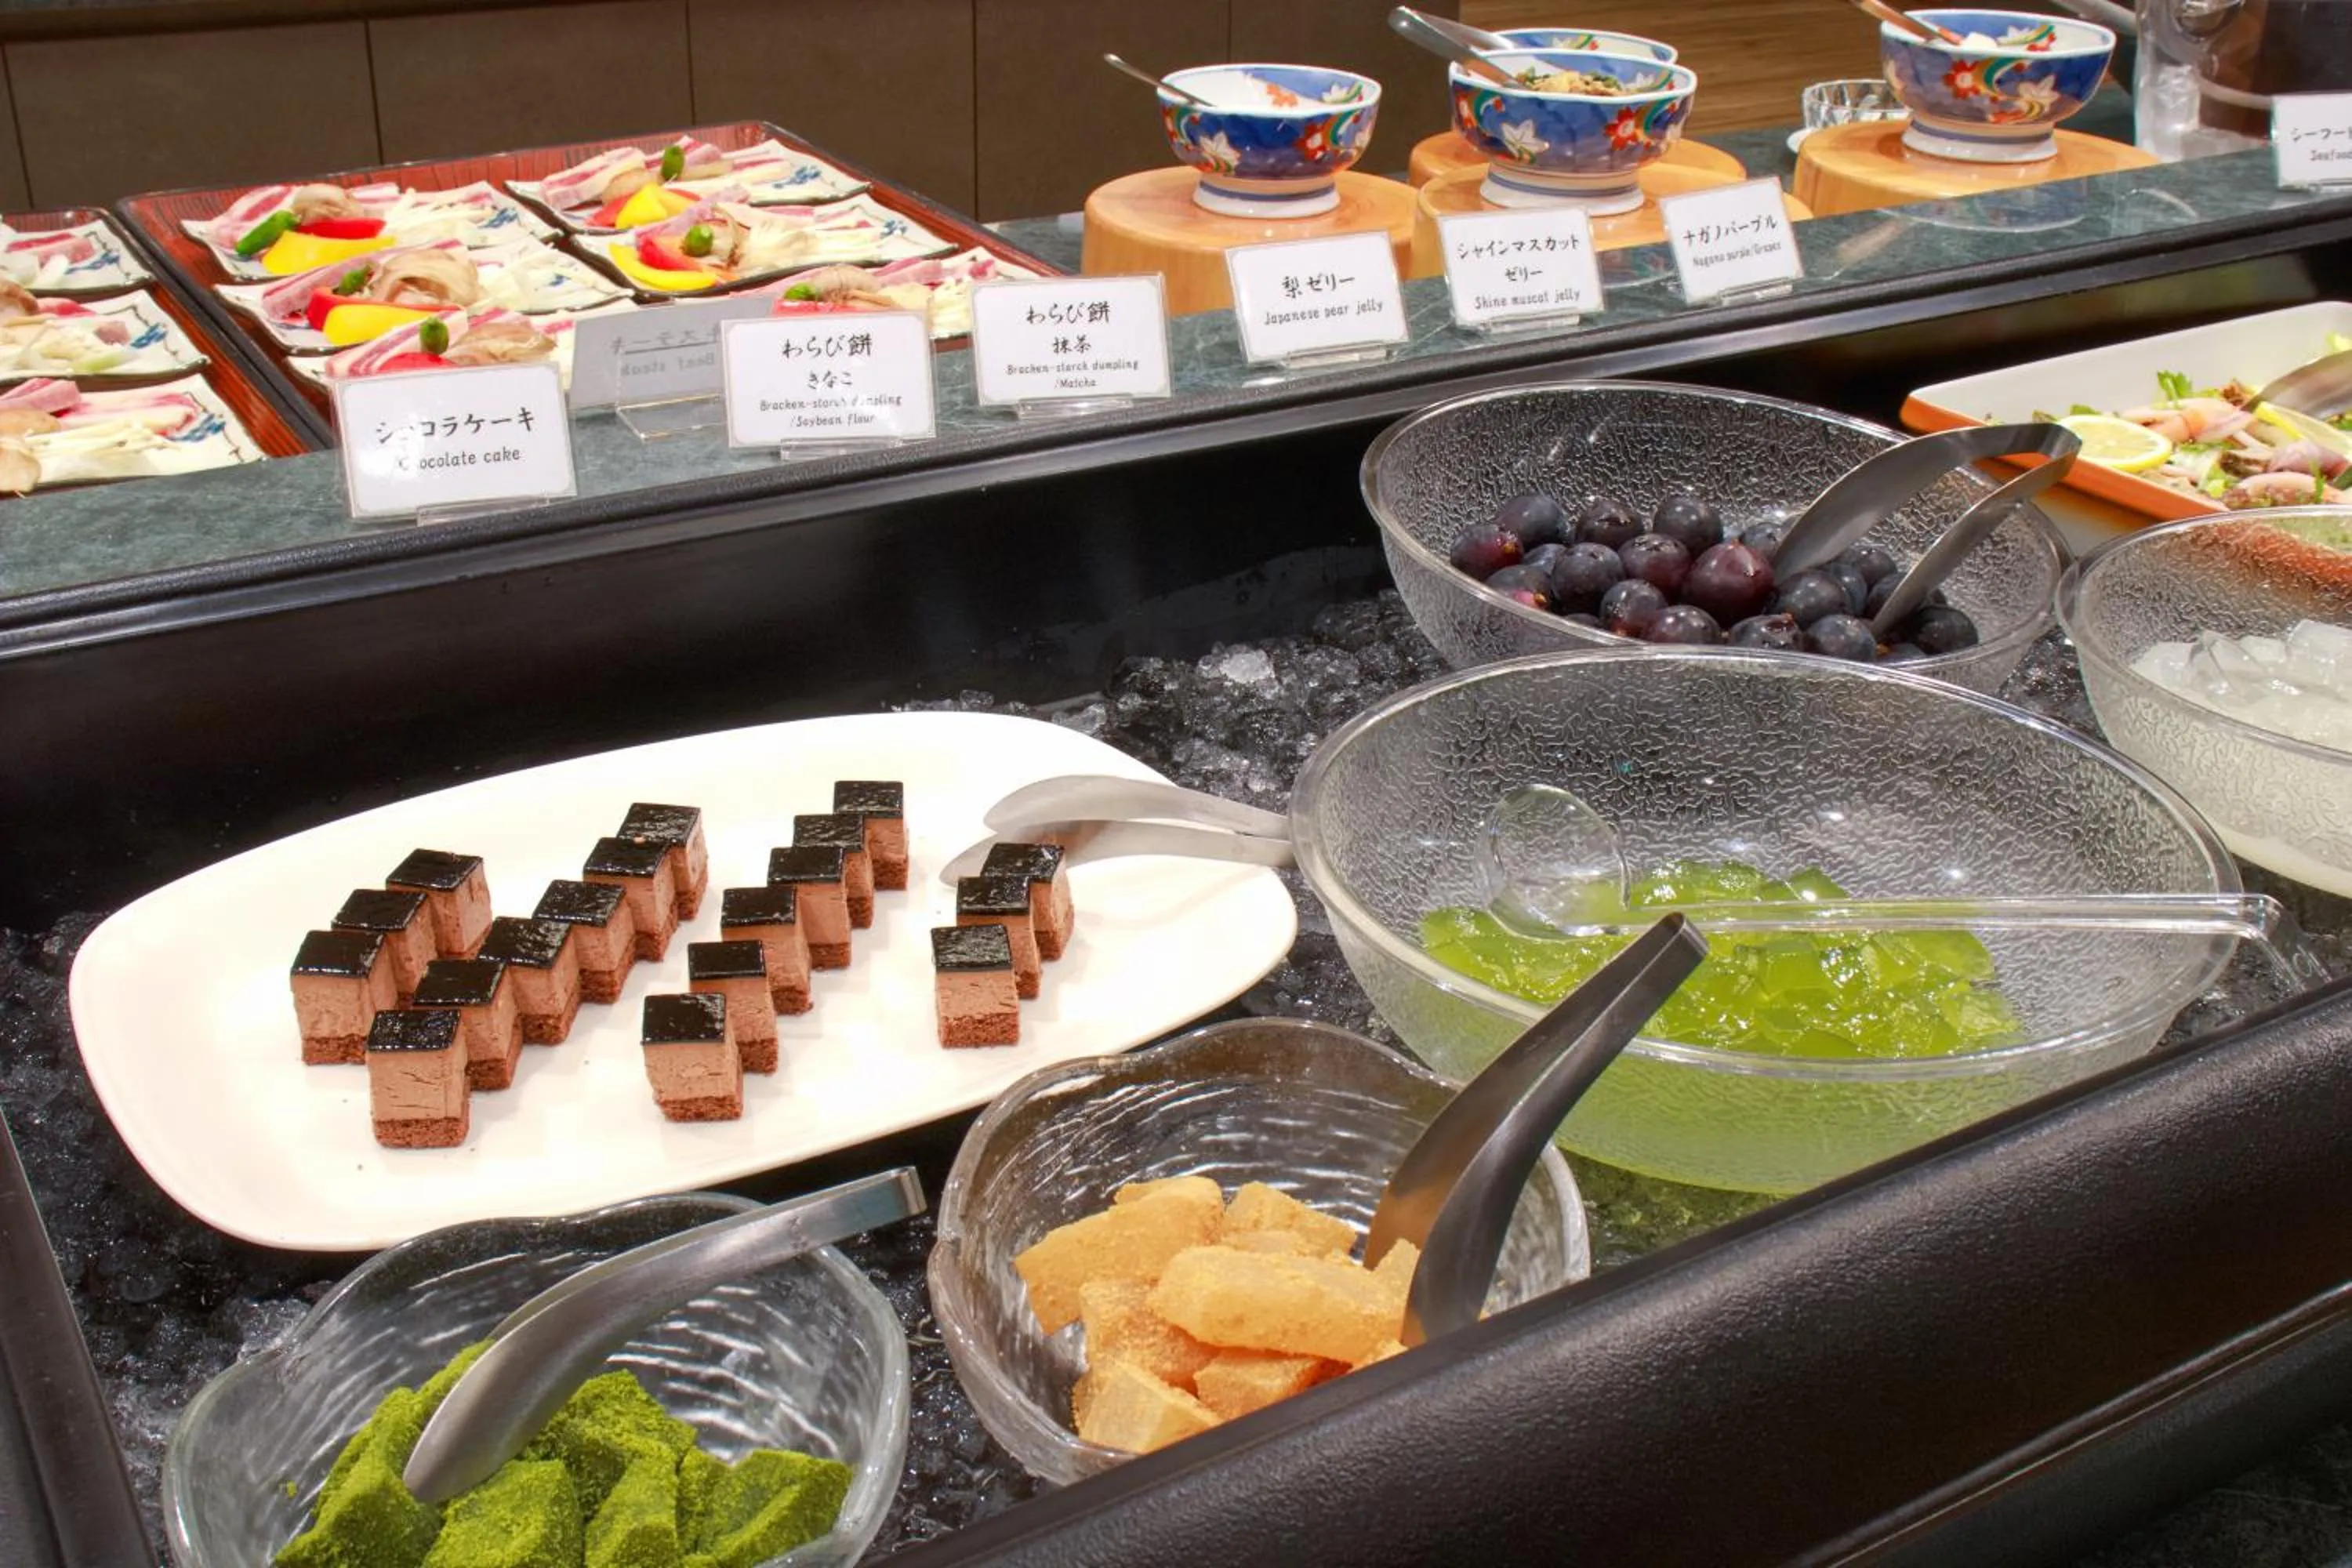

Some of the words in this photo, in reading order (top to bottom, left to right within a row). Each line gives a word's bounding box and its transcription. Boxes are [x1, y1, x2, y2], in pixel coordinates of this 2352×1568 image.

[1457, 234, 1579, 260] シャインマスカット
[1504, 266, 1543, 281] ゼリー
[1282, 273, 1356, 299] 梨ゼリー
[1475, 296, 1507, 309] Shine
[1511, 291, 1549, 304] muscat
[1555, 288, 1581, 303] jelly
[1026, 300, 1110, 324] わらび餅
[1265, 308, 1319, 325] Japanese
[1324, 306, 1348, 318] pear
[1356, 298, 1384, 316] jelly
[782, 333, 873, 358] わらび餅
[1052, 333, 1091, 354] 抹茶
[1092, 358, 1139, 371] dumpling
[808, 370, 853, 389] きなこ
[847, 414, 876, 426] flour
[398, 450, 477, 471] Cocolate
[483, 446, 521, 463] cake
